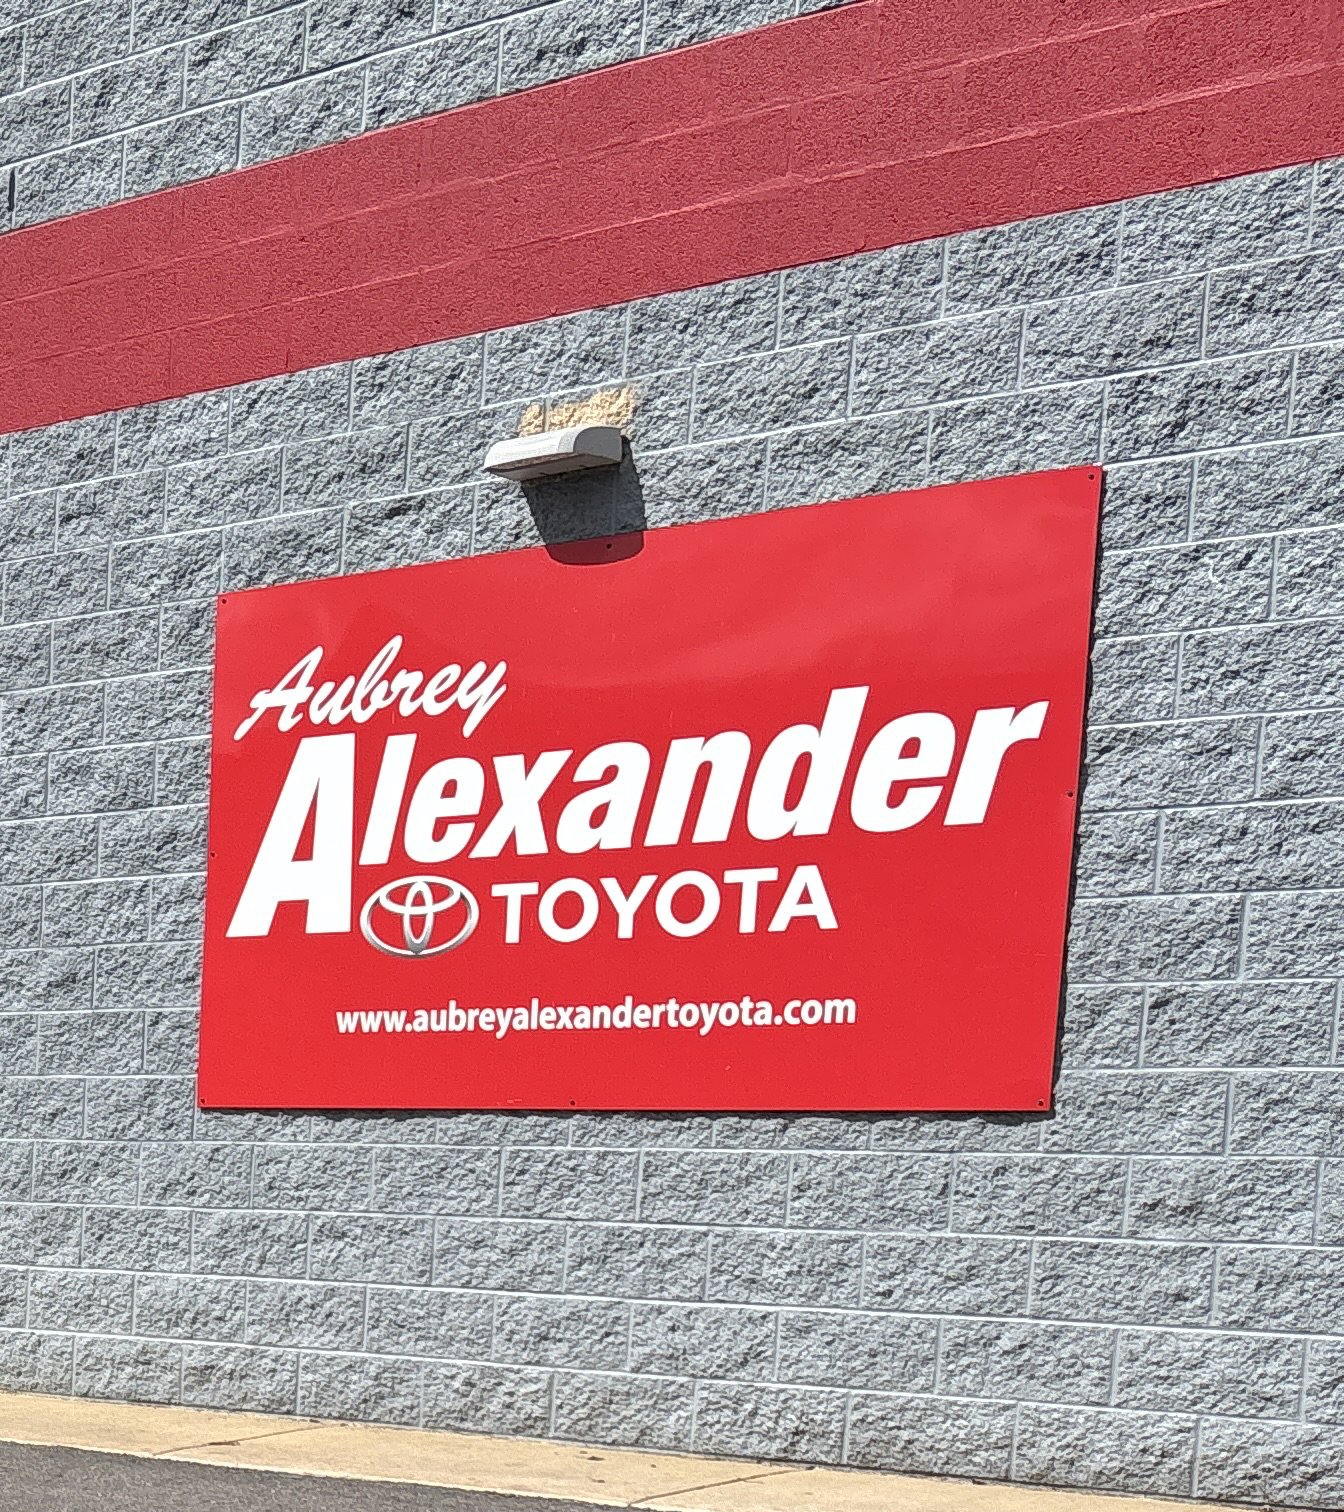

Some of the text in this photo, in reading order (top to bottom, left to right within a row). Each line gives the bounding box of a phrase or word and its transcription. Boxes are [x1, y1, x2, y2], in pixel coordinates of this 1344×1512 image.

[233, 634, 507, 741] Aubrey
[224, 685, 1050, 938] Alexander
[491, 864, 839, 944] TOYOTA
[335, 994, 857, 1036] www.aubreyalexandertoyota.com
